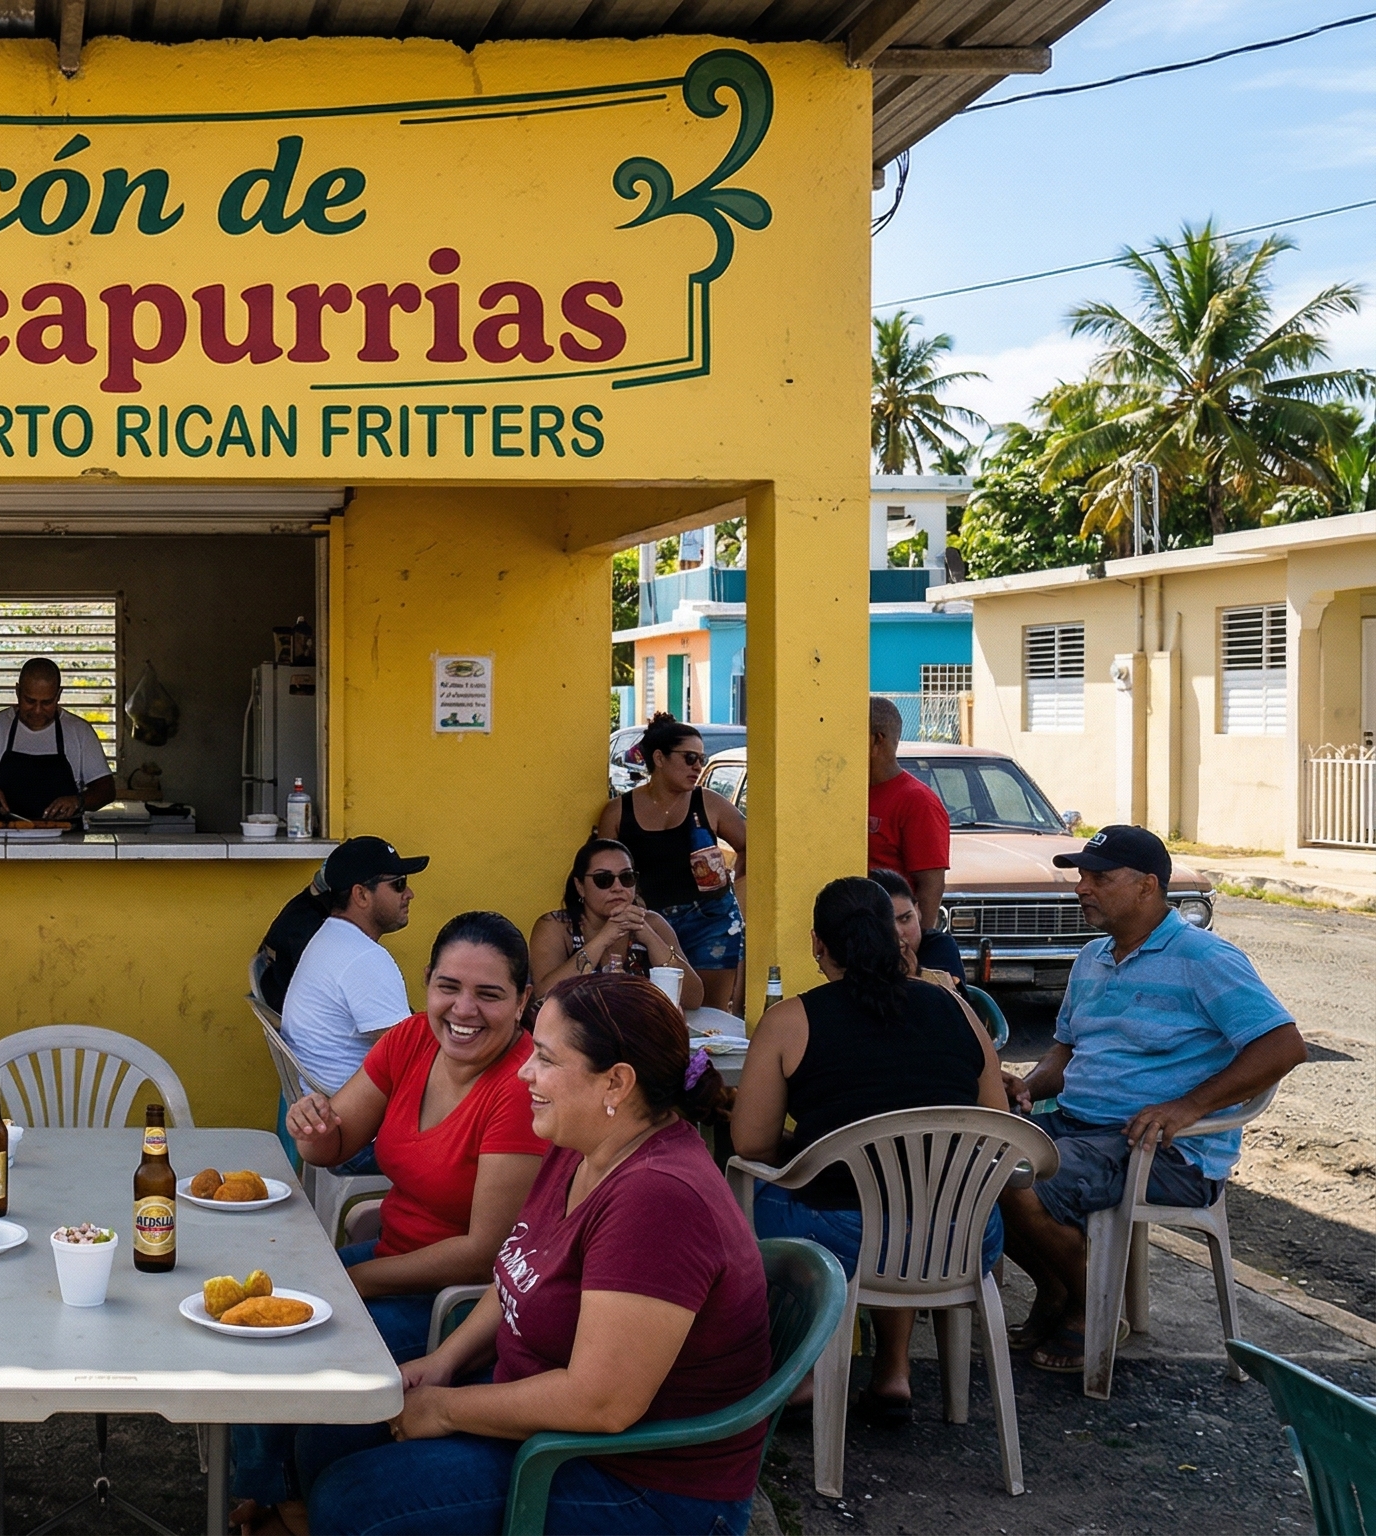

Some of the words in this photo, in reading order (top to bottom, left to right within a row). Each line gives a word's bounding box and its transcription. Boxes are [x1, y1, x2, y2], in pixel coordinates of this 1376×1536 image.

[217, 135, 366, 235] de
[116, 404, 298, 457] RICAN
[322, 404, 605, 458] FRITTERS
